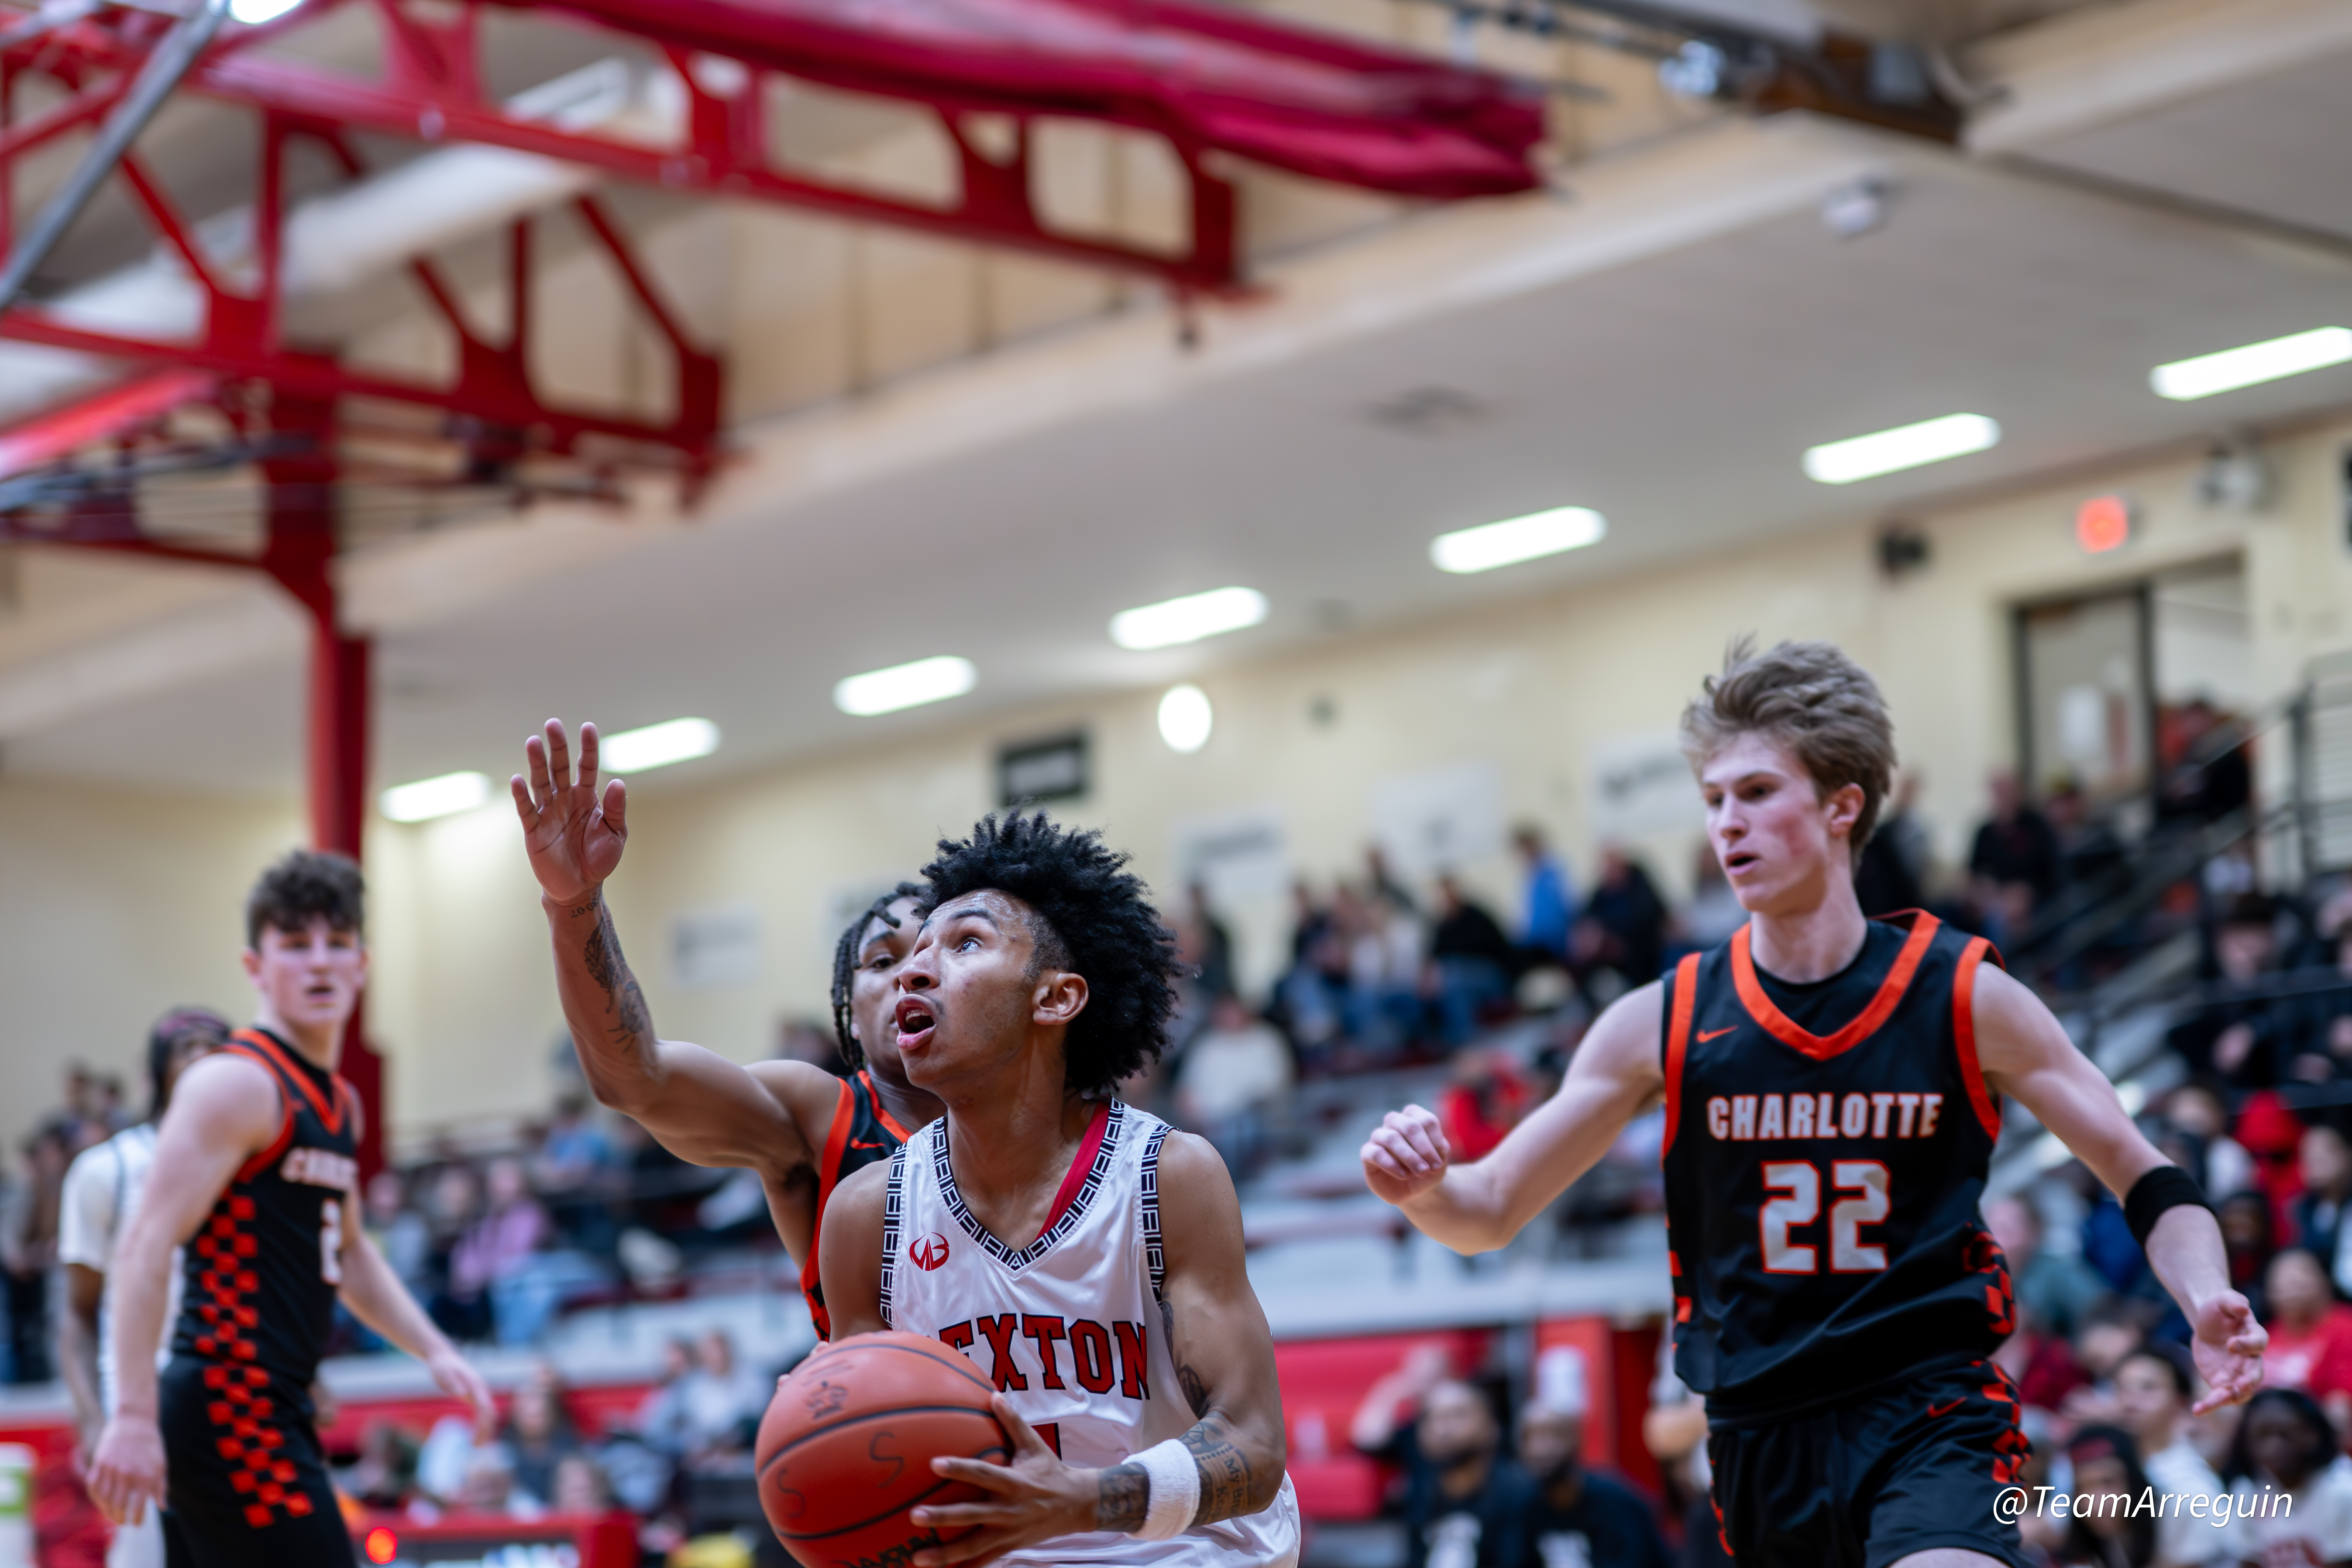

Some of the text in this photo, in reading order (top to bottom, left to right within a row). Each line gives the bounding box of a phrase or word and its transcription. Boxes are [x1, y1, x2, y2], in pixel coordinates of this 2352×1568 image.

[1707, 1092, 1944, 1140] CHARLOTTE
[1760, 1159, 1892, 1274] 22
[927, 1313, 1150, 1400] XTON
